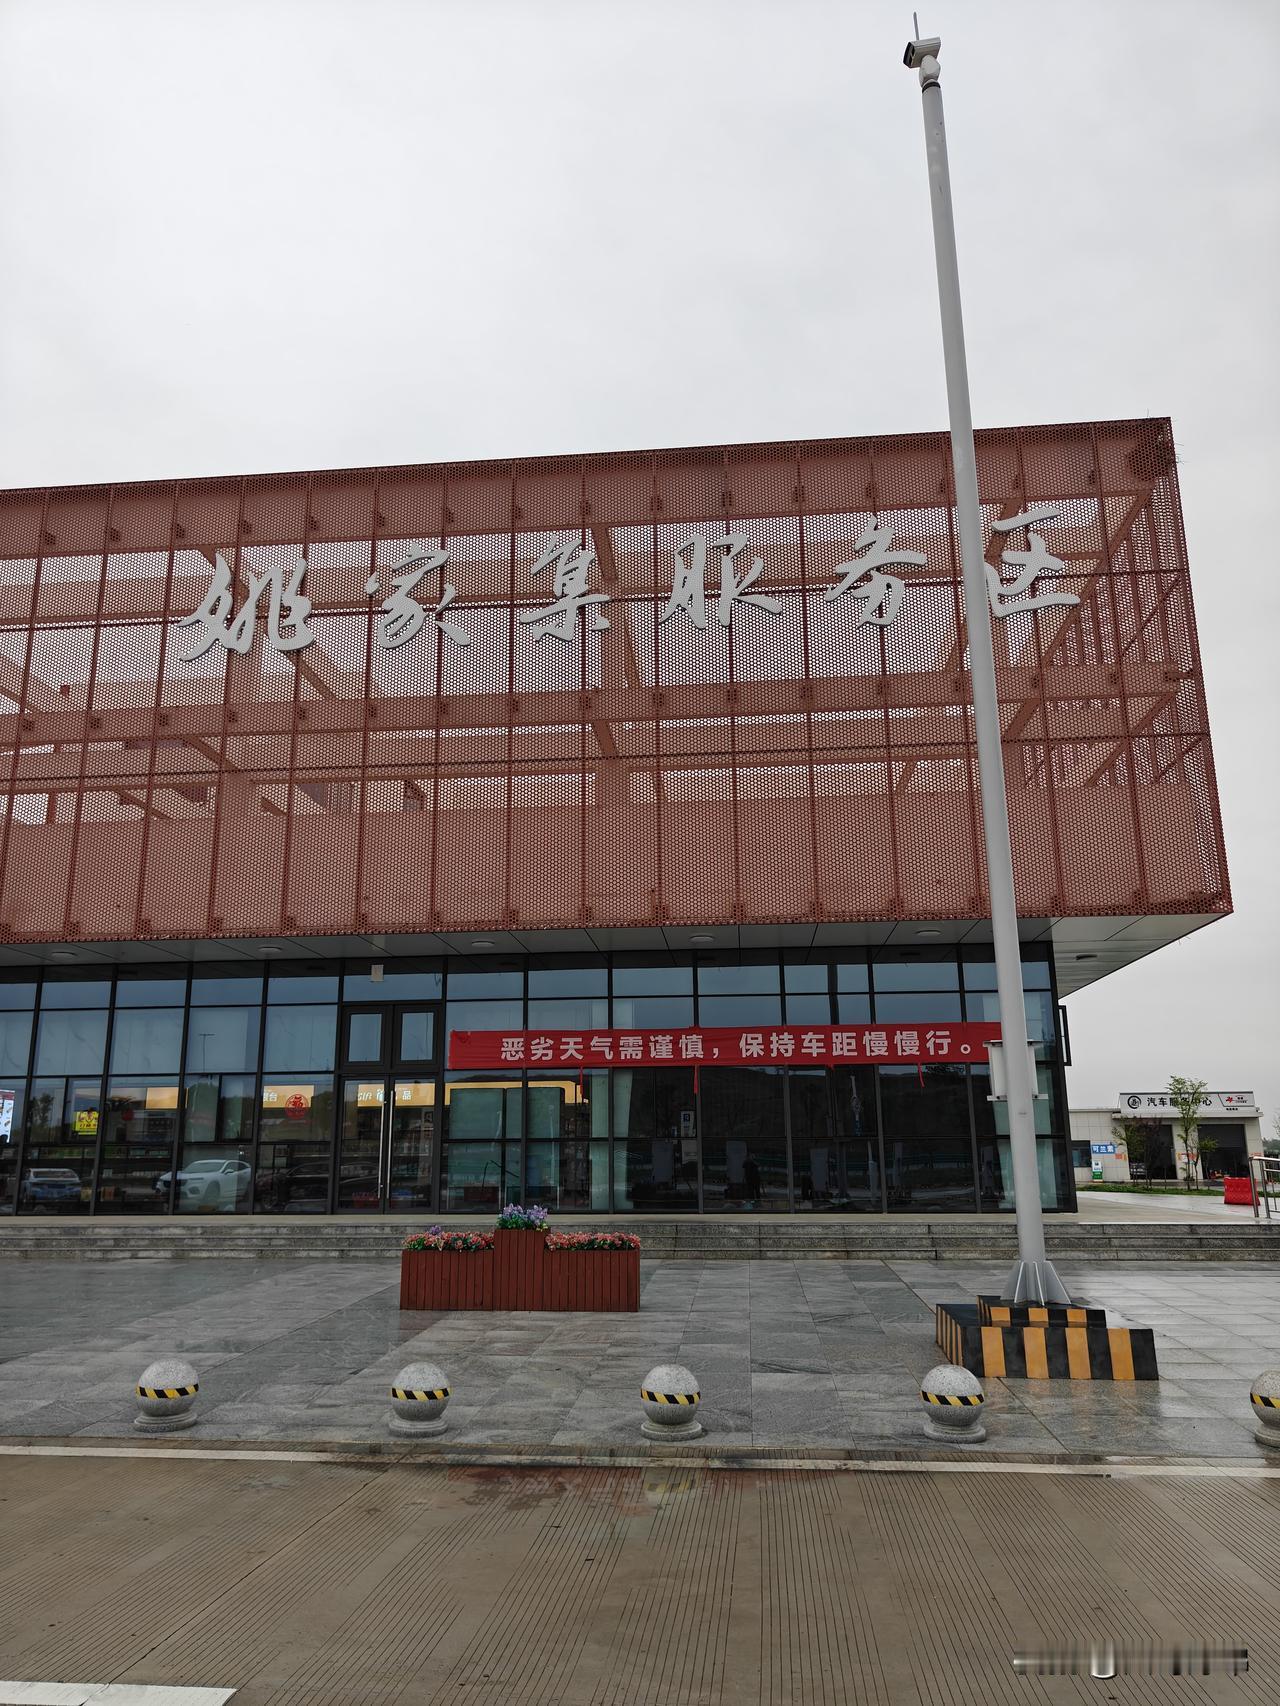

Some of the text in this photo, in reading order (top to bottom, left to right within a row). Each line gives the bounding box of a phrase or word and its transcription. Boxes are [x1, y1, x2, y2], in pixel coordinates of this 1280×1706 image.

[177, 507, 1081, 662] 姚家集服务区
[1147, 1096, 1213, 1107] 汽车服务心
